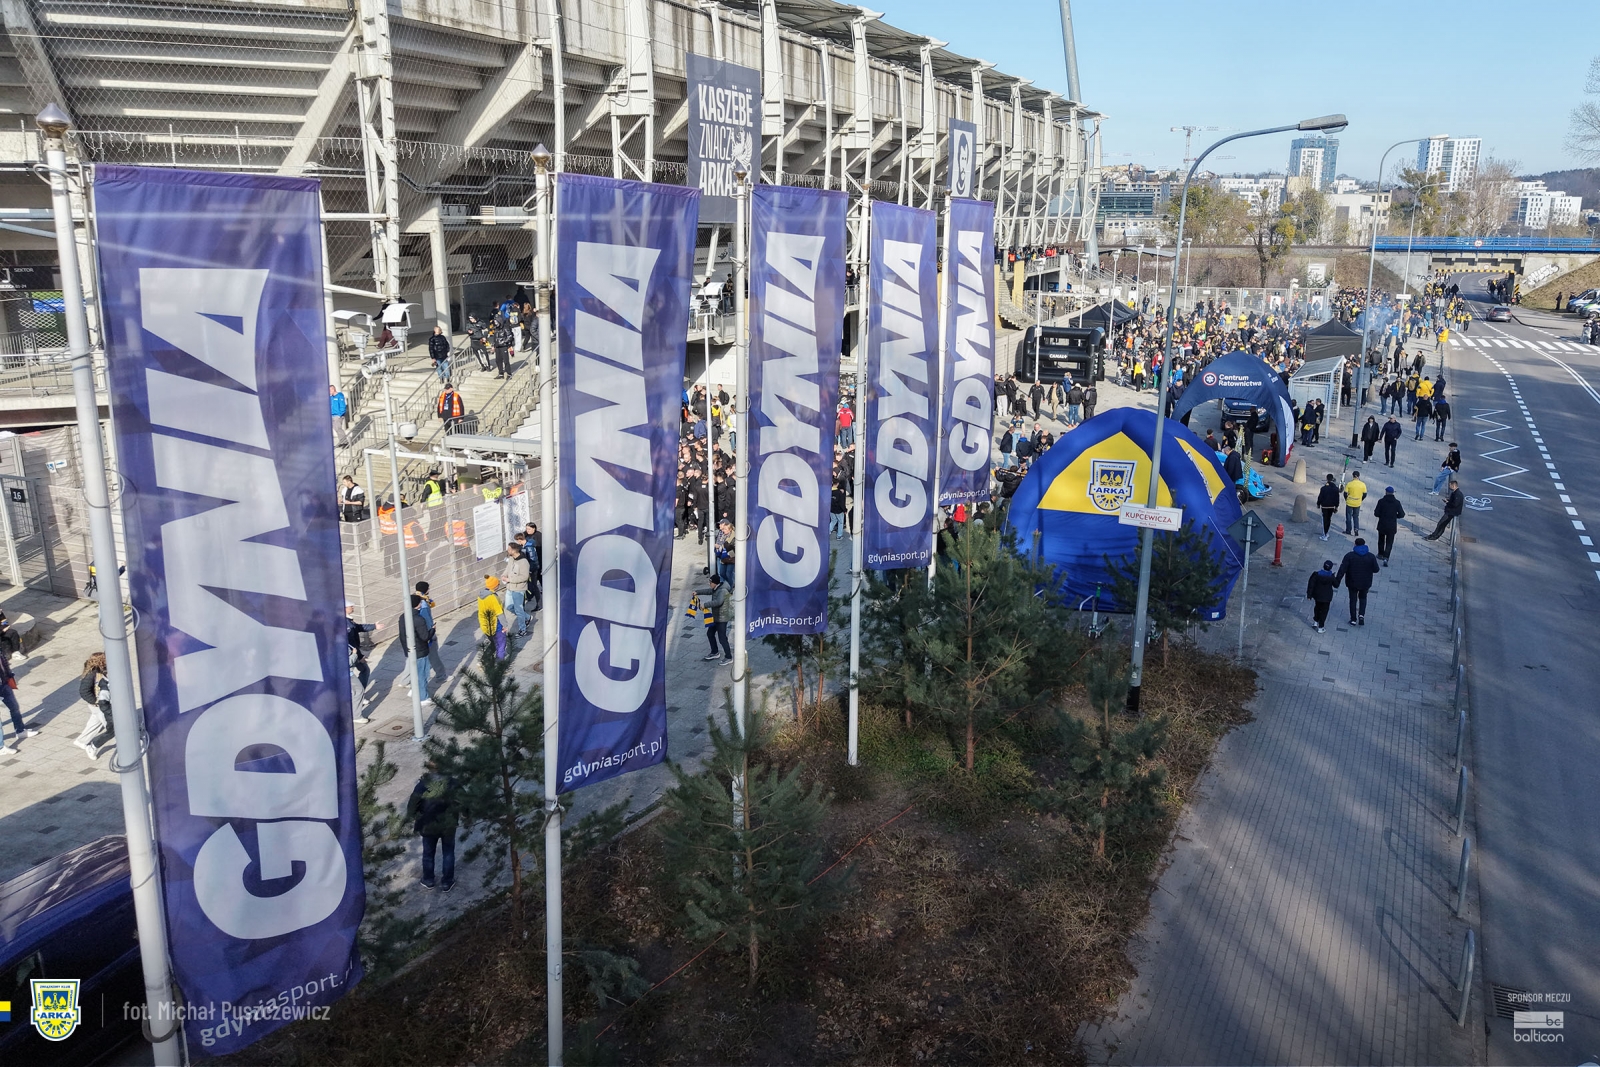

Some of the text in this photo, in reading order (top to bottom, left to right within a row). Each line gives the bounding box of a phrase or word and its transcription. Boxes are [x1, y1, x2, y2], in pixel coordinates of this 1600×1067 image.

[698, 84, 753, 127] KASZËBË
[699, 161, 733, 196] ARKA
[948, 230, 991, 471] GDYNIA
[875, 239, 928, 528] GDYNIA
[756, 231, 826, 588] GDYNIA
[13, 491, 22, 500] 16
[574, 241, 661, 713] GDYNIA
[939, 488, 988, 501] gdyniasport.pl
[1125, 511, 1172, 523] KUPCEWICZA
[868, 549, 929, 564] gdyniasport.pl
[139, 268, 347, 939] GDYNIA
[749, 612, 823, 633] gdyniasport.pl
[563, 737, 662, 783] gdyniasport.pl
